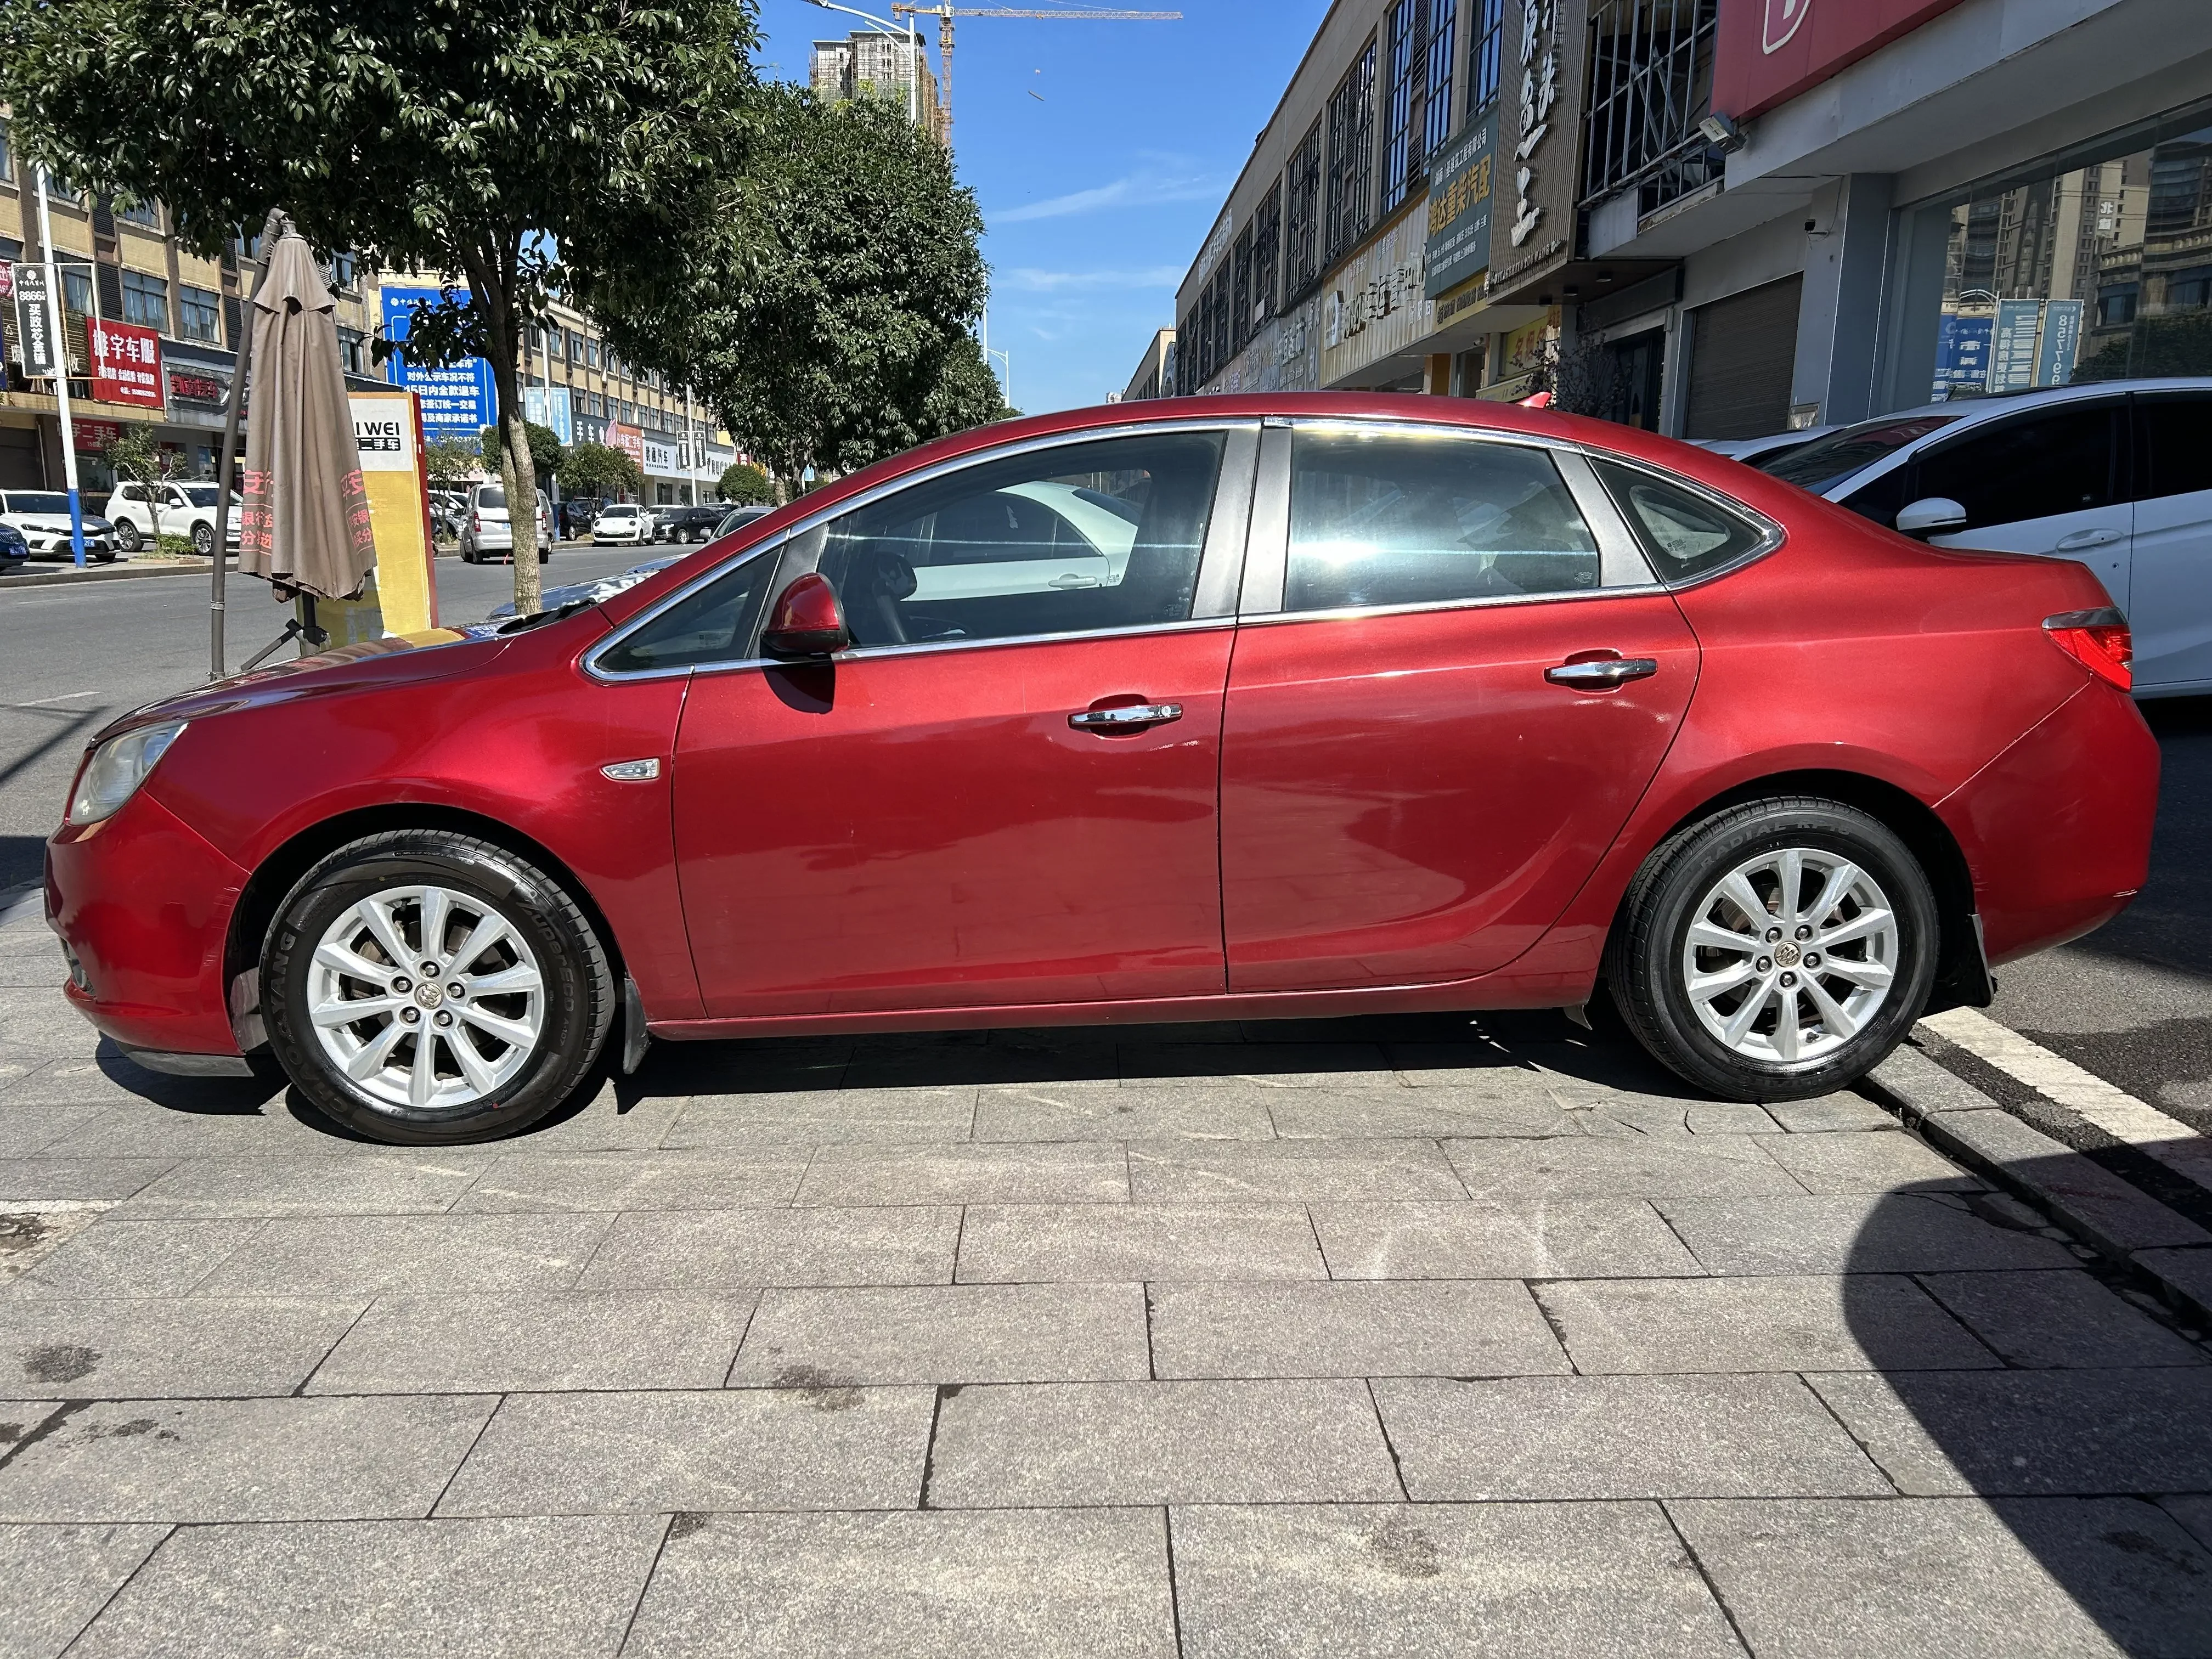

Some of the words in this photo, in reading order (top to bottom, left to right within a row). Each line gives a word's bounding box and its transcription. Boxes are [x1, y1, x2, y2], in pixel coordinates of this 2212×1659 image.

[1435, 127, 1487, 188] 湖南基建筑工程有限公司
[19, 290, 42, 301] 8866
[407, 371, 475, 383] 对外公示车况不符
[404, 385, 481, 397] 15日内全款退车
[364, 422, 400, 436] WEI
